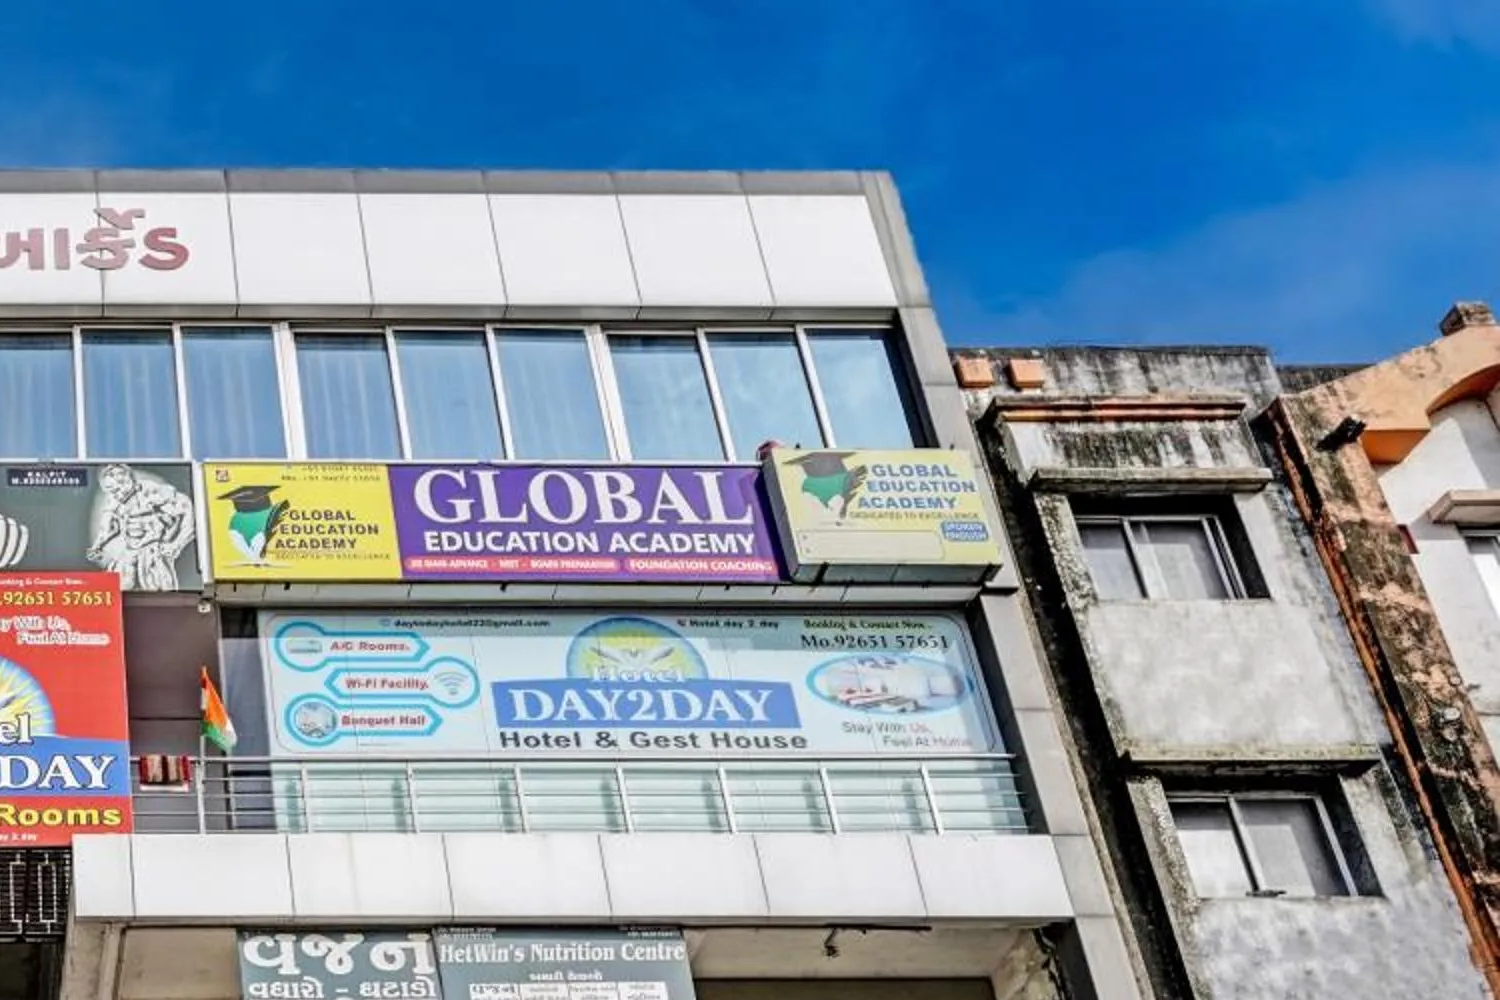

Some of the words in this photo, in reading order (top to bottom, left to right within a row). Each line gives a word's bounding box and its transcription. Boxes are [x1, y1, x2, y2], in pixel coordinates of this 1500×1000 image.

[871, 464, 959, 477] GLOBAL
[866, 479, 977, 493] EDUCATION
[413, 468, 755, 526] GLOBAL
[857, 496, 959, 509] ACADEMY
[289, 509, 357, 521] GLOBAL
[278, 523, 380, 536] EDUCATION
[274, 537, 358, 550] ACADEMY
[423, 531, 599, 554] EDUCATION
[609, 532, 756, 554] ACADEMY
[61, 590, 112, 606] 57651
[799, 633, 888, 649] Mo.92651
[895, 634, 950, 649] 57651
[345, 677, 377, 689] Wi-Fi
[508, 687, 773, 722] DAY2DAY
[341, 714, 397, 728] Banquet
[399, 714, 427, 726] Hall
[499, 731, 583, 749] Hotel
[595, 731, 619, 749] &
[629, 731, 702, 749] Gest
[710, 732, 808, 749] House
[439, 943, 525, 963] HetWin's
[530, 942, 616, 962] Nutrition
[621, 941, 685, 961] Centre
